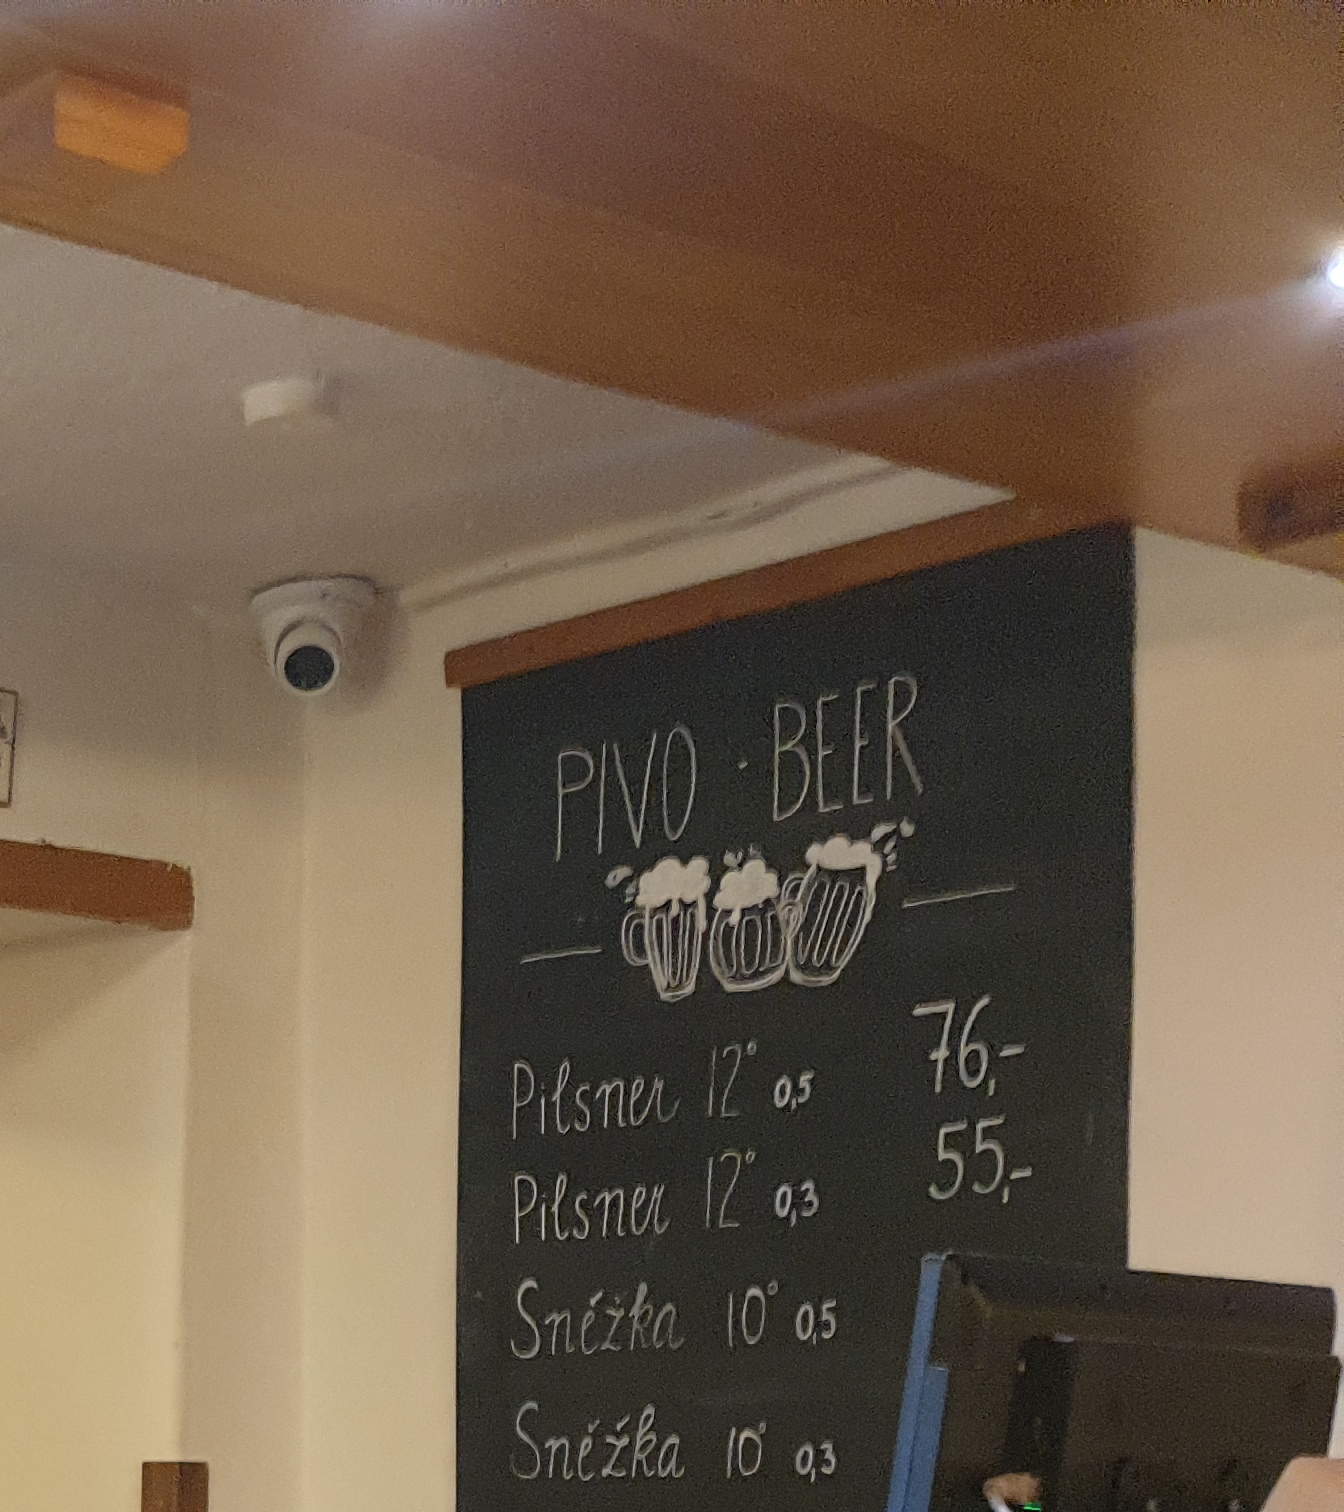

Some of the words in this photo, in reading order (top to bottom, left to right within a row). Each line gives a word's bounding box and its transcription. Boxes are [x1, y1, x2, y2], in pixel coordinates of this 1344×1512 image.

[555, 722, 698, 862] PIVO
[771, 674, 924, 822] BEER
[511, 1058, 681, 1141] Pilsner
[912, 994, 1026, 1097] 76,-
[512, 1171, 671, 1246] Pilsner
[927, 1115, 1033, 1204] 55,-
[510, 1276, 686, 1360] Sněžka
[511, 1400, 687, 1482] Sněžka
